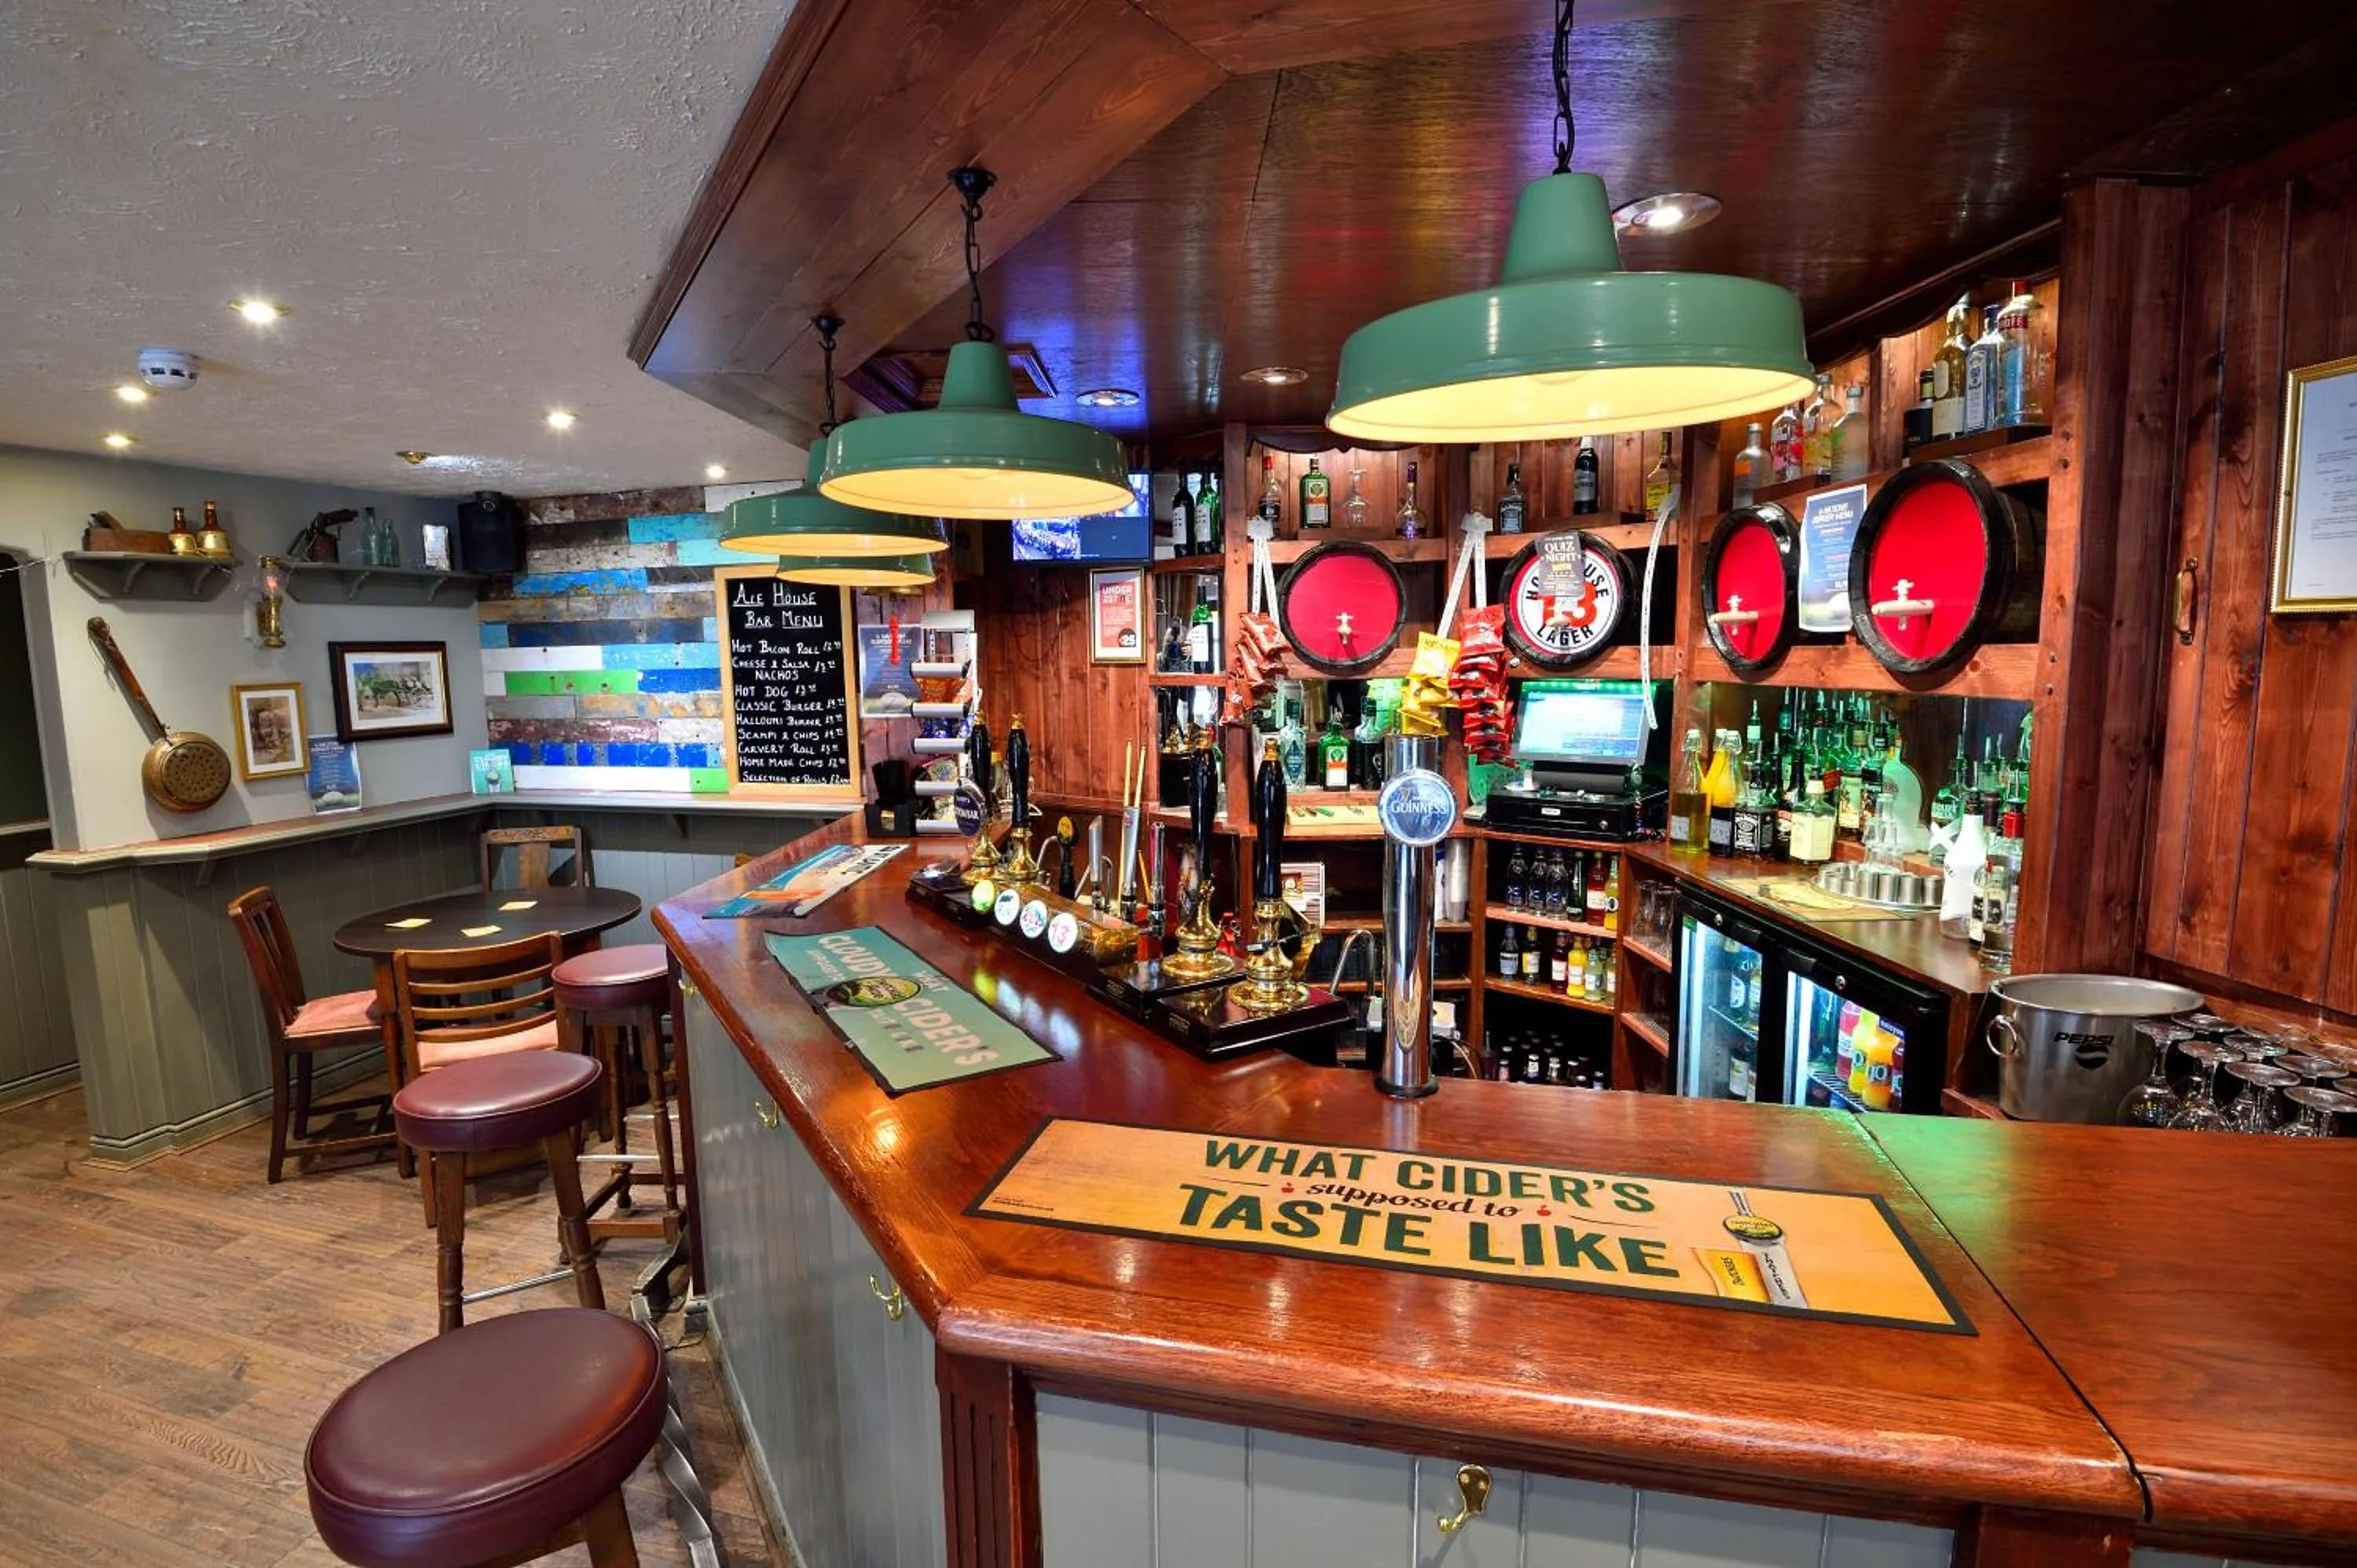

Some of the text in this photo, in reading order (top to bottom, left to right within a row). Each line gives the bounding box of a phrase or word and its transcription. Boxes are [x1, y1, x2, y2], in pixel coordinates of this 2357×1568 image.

[1545, 541, 1574, 554] QUIZ
[1545, 552, 1577, 562] NIGHT
[1537, 624, 1594, 646] LAGER
[755, 670, 799, 681] NACHOS
[735, 684, 755, 697] HOT
[764, 686, 790, 698] DOG
[1391, 800, 1446, 815] GUINNESS
[893, 998, 999, 1066] CIDER'S
[2054, 1031, 2114, 1046] PEPSI
[1205, 1140, 1656, 1213] WHAT CIDER'S
[1305, 1182, 1523, 1218] supposed to
[1179, 1183, 1432, 1256] TASTE
[1468, 1221, 1681, 1278] LIKE
